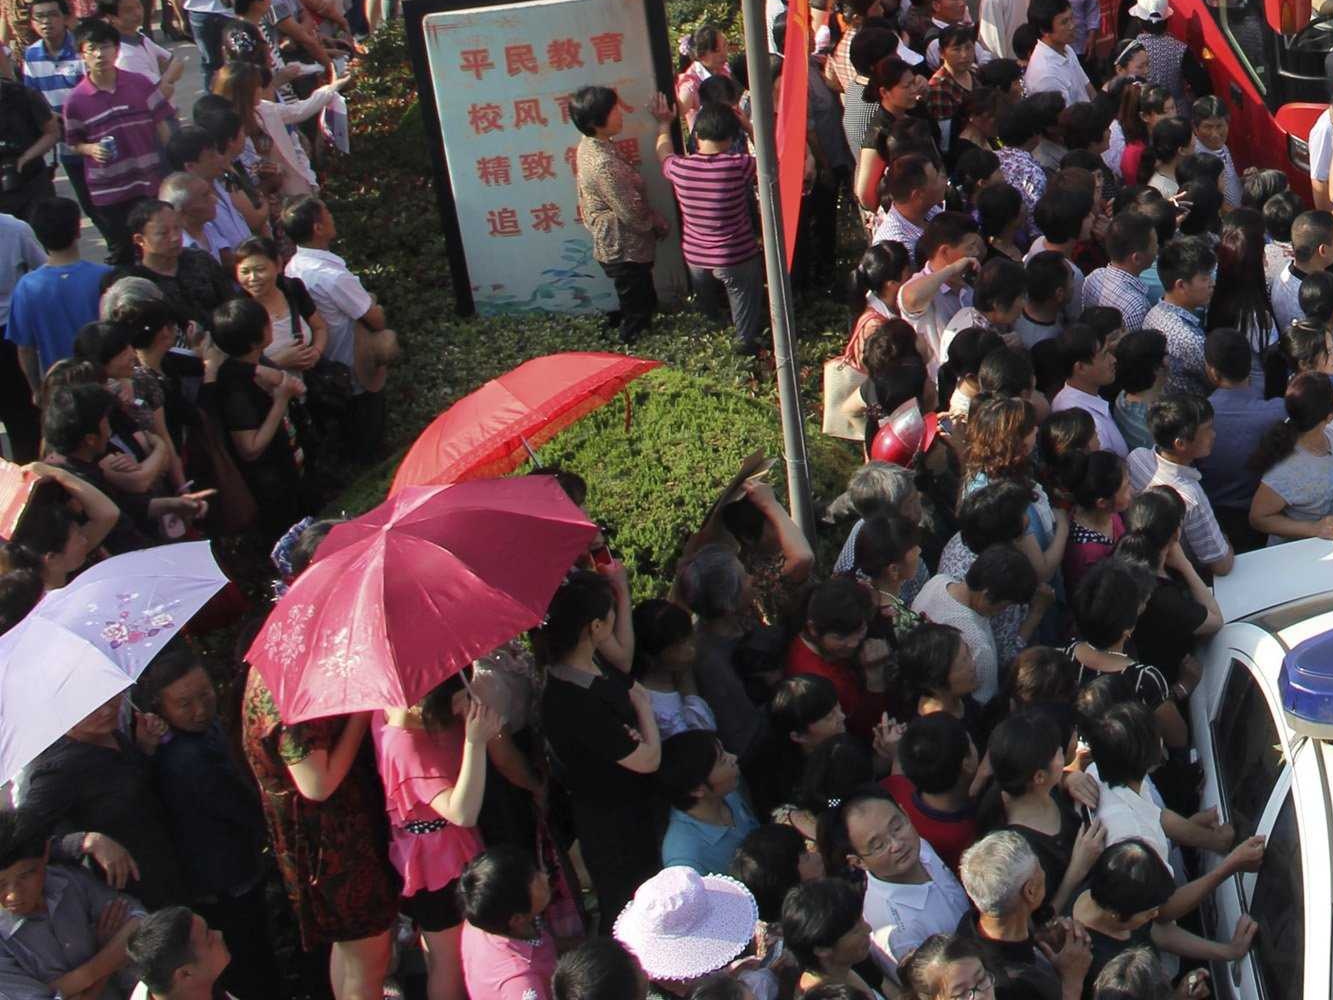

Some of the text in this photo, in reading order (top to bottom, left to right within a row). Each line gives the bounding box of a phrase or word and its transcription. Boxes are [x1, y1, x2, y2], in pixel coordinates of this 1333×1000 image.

[459, 31, 625, 81] 平民教育
[486, 202, 588, 238] 追求
